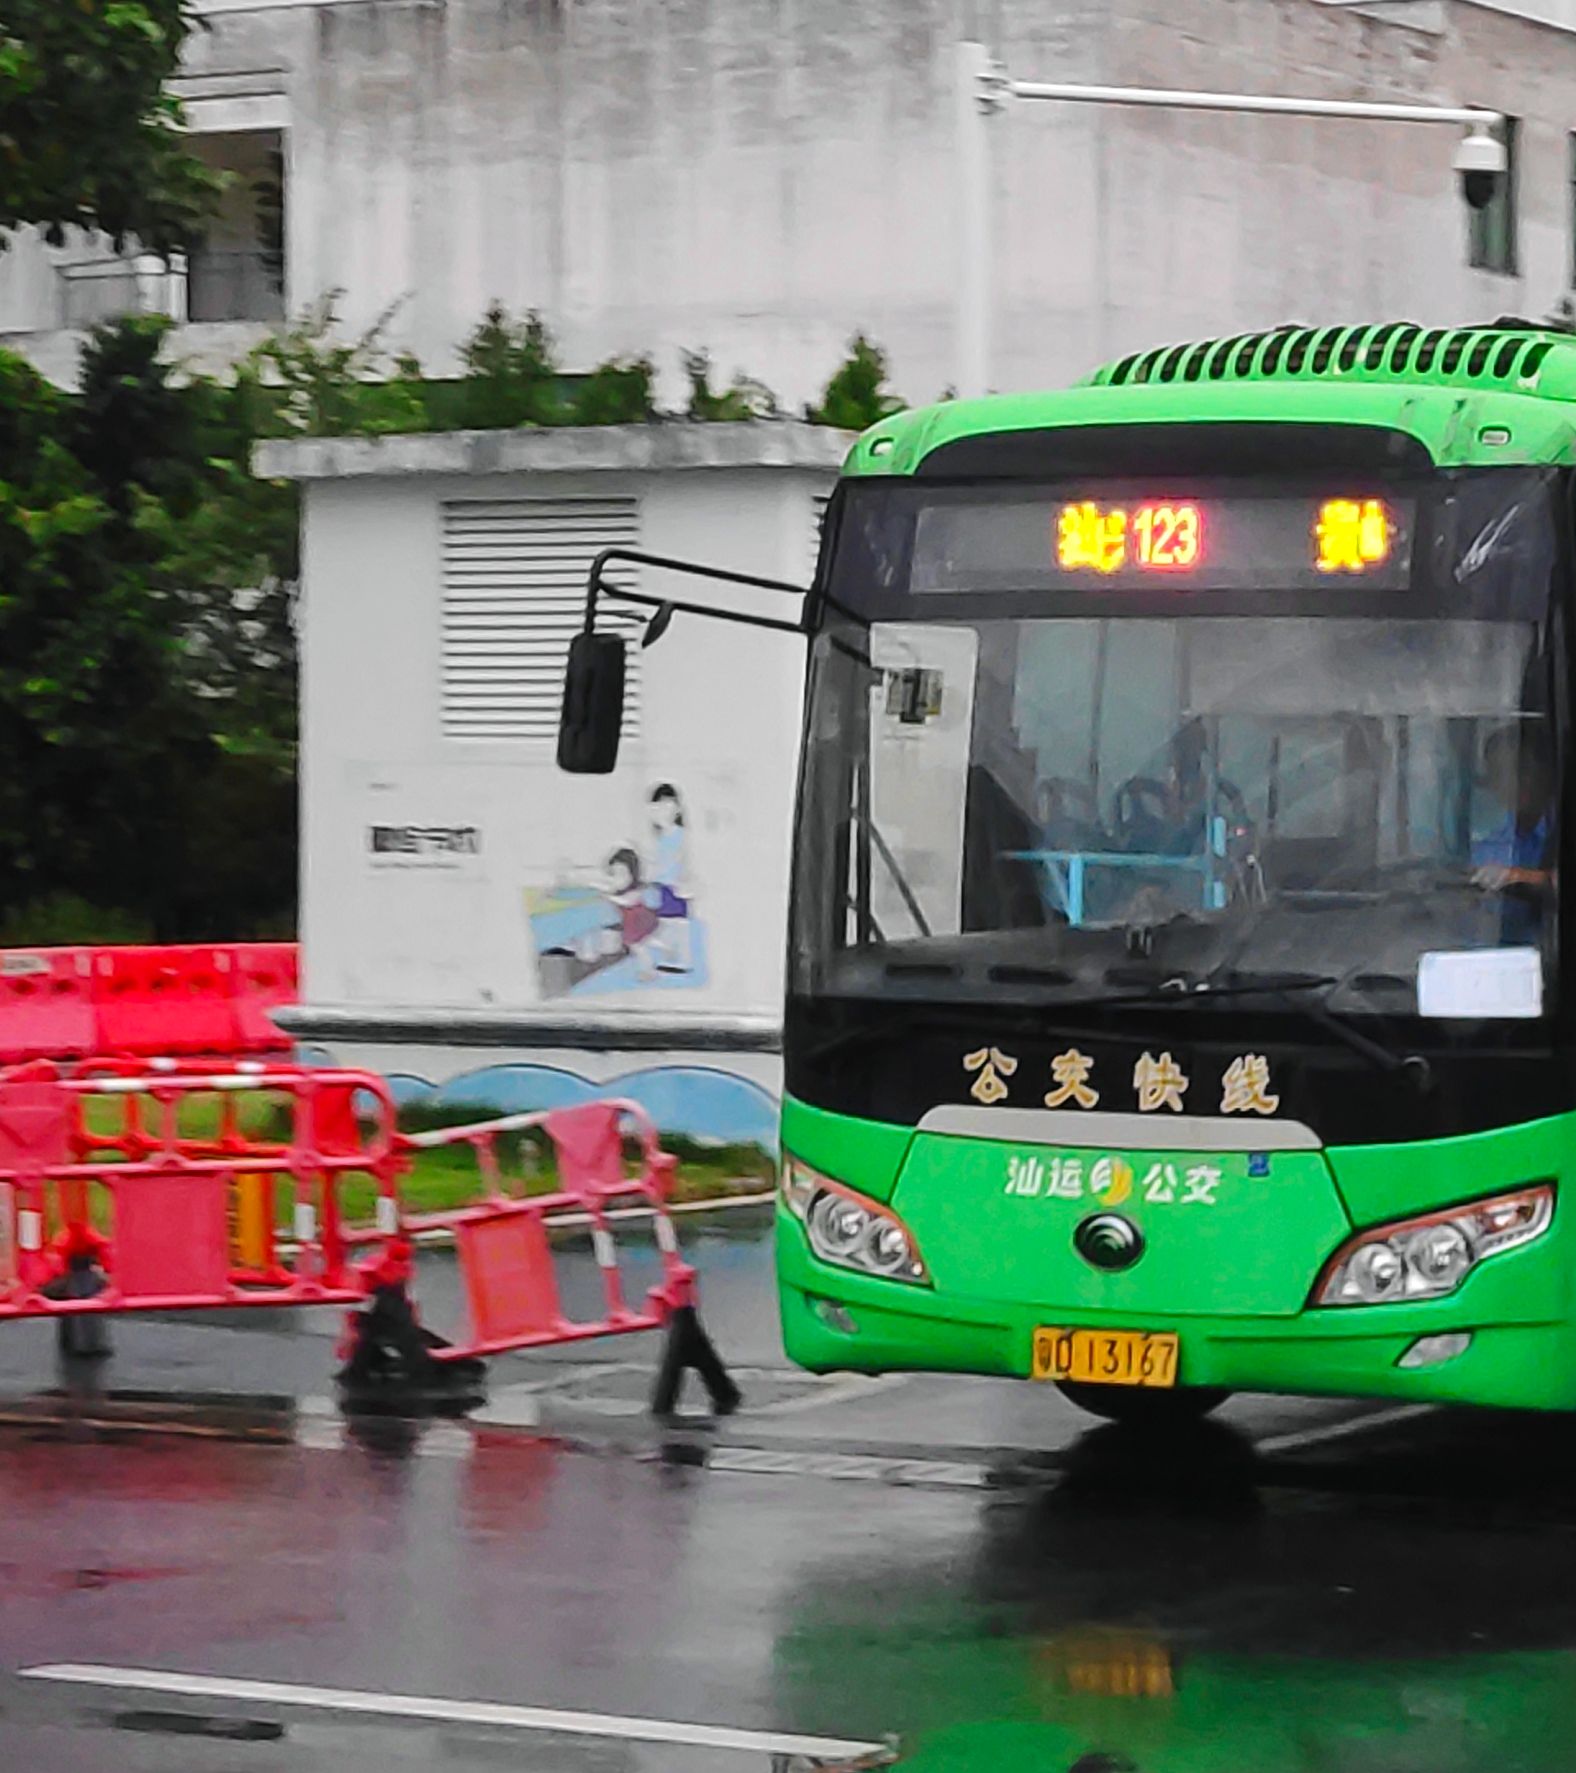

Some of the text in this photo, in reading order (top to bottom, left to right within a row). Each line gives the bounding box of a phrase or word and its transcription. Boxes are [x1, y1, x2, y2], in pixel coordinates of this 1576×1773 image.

[1134, 506, 1198, 564] 123
[963, 1046, 1280, 1114] 公交快线
[1004, 1156, 1085, 1200] 汕运
[1141, 1163, 1222, 1205] 公交
